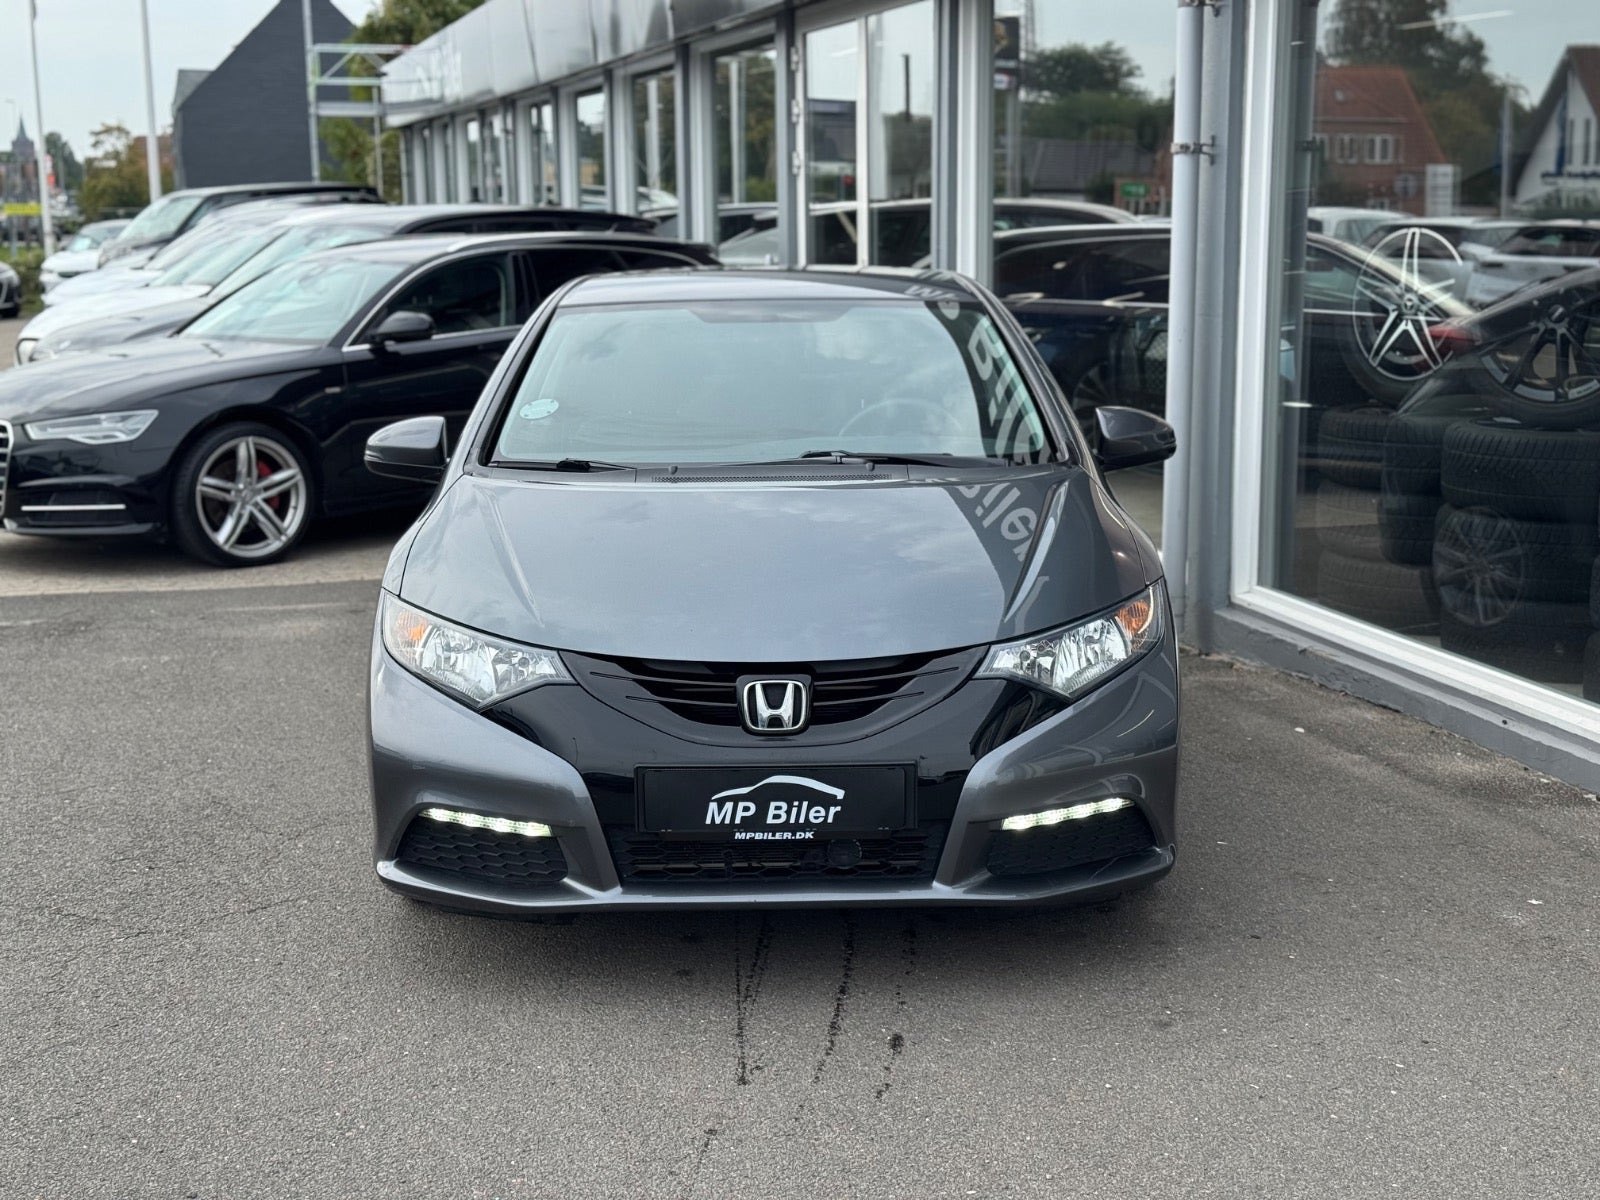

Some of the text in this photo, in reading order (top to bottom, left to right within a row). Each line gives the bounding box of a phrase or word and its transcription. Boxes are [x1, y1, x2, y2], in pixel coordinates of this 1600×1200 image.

[705, 801, 842, 825] MP Biler
[734, 831, 815, 840] MPBILER.DK
